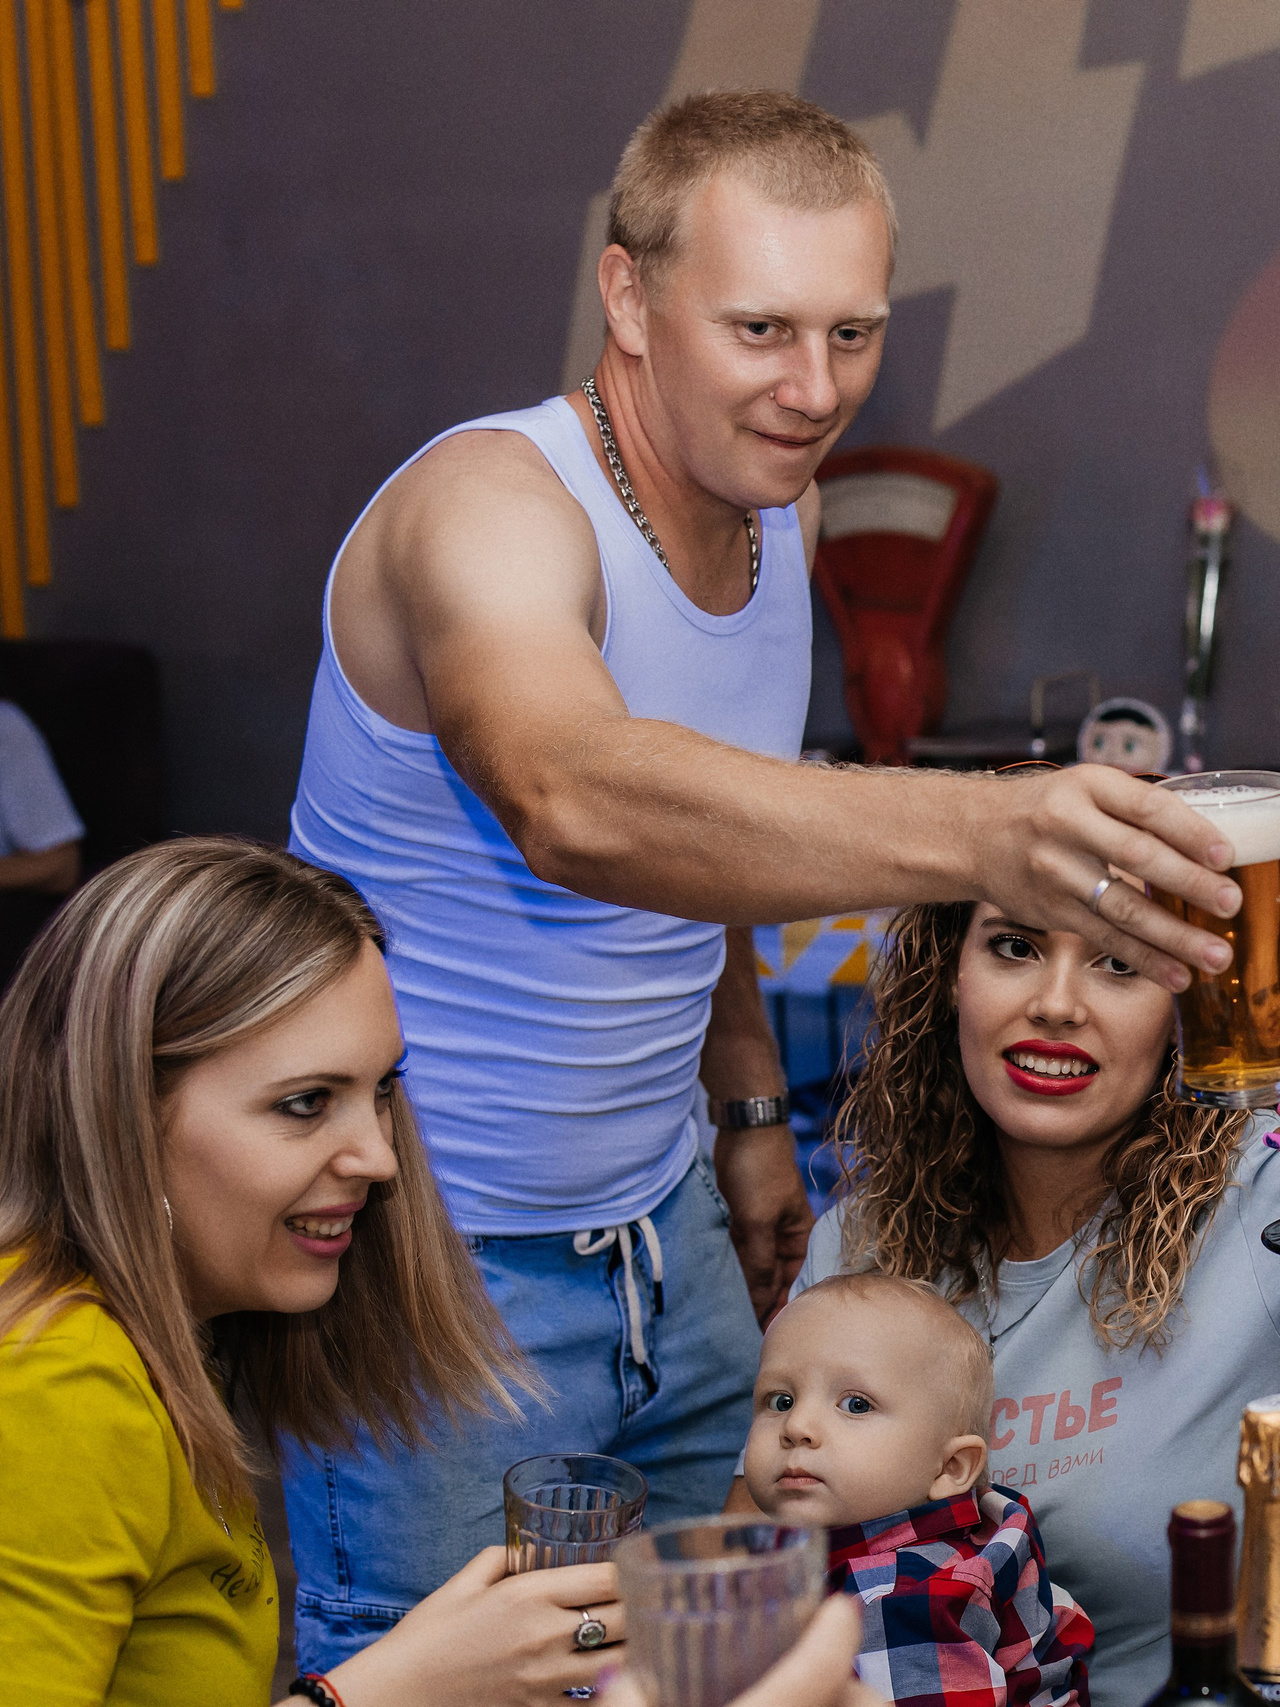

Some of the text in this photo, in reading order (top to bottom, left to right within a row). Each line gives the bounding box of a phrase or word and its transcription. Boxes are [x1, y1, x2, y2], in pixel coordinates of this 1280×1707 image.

[989, 1376, 1123, 1451] СТЬЕ
[992, 1446, 1104, 1488] ред вами
